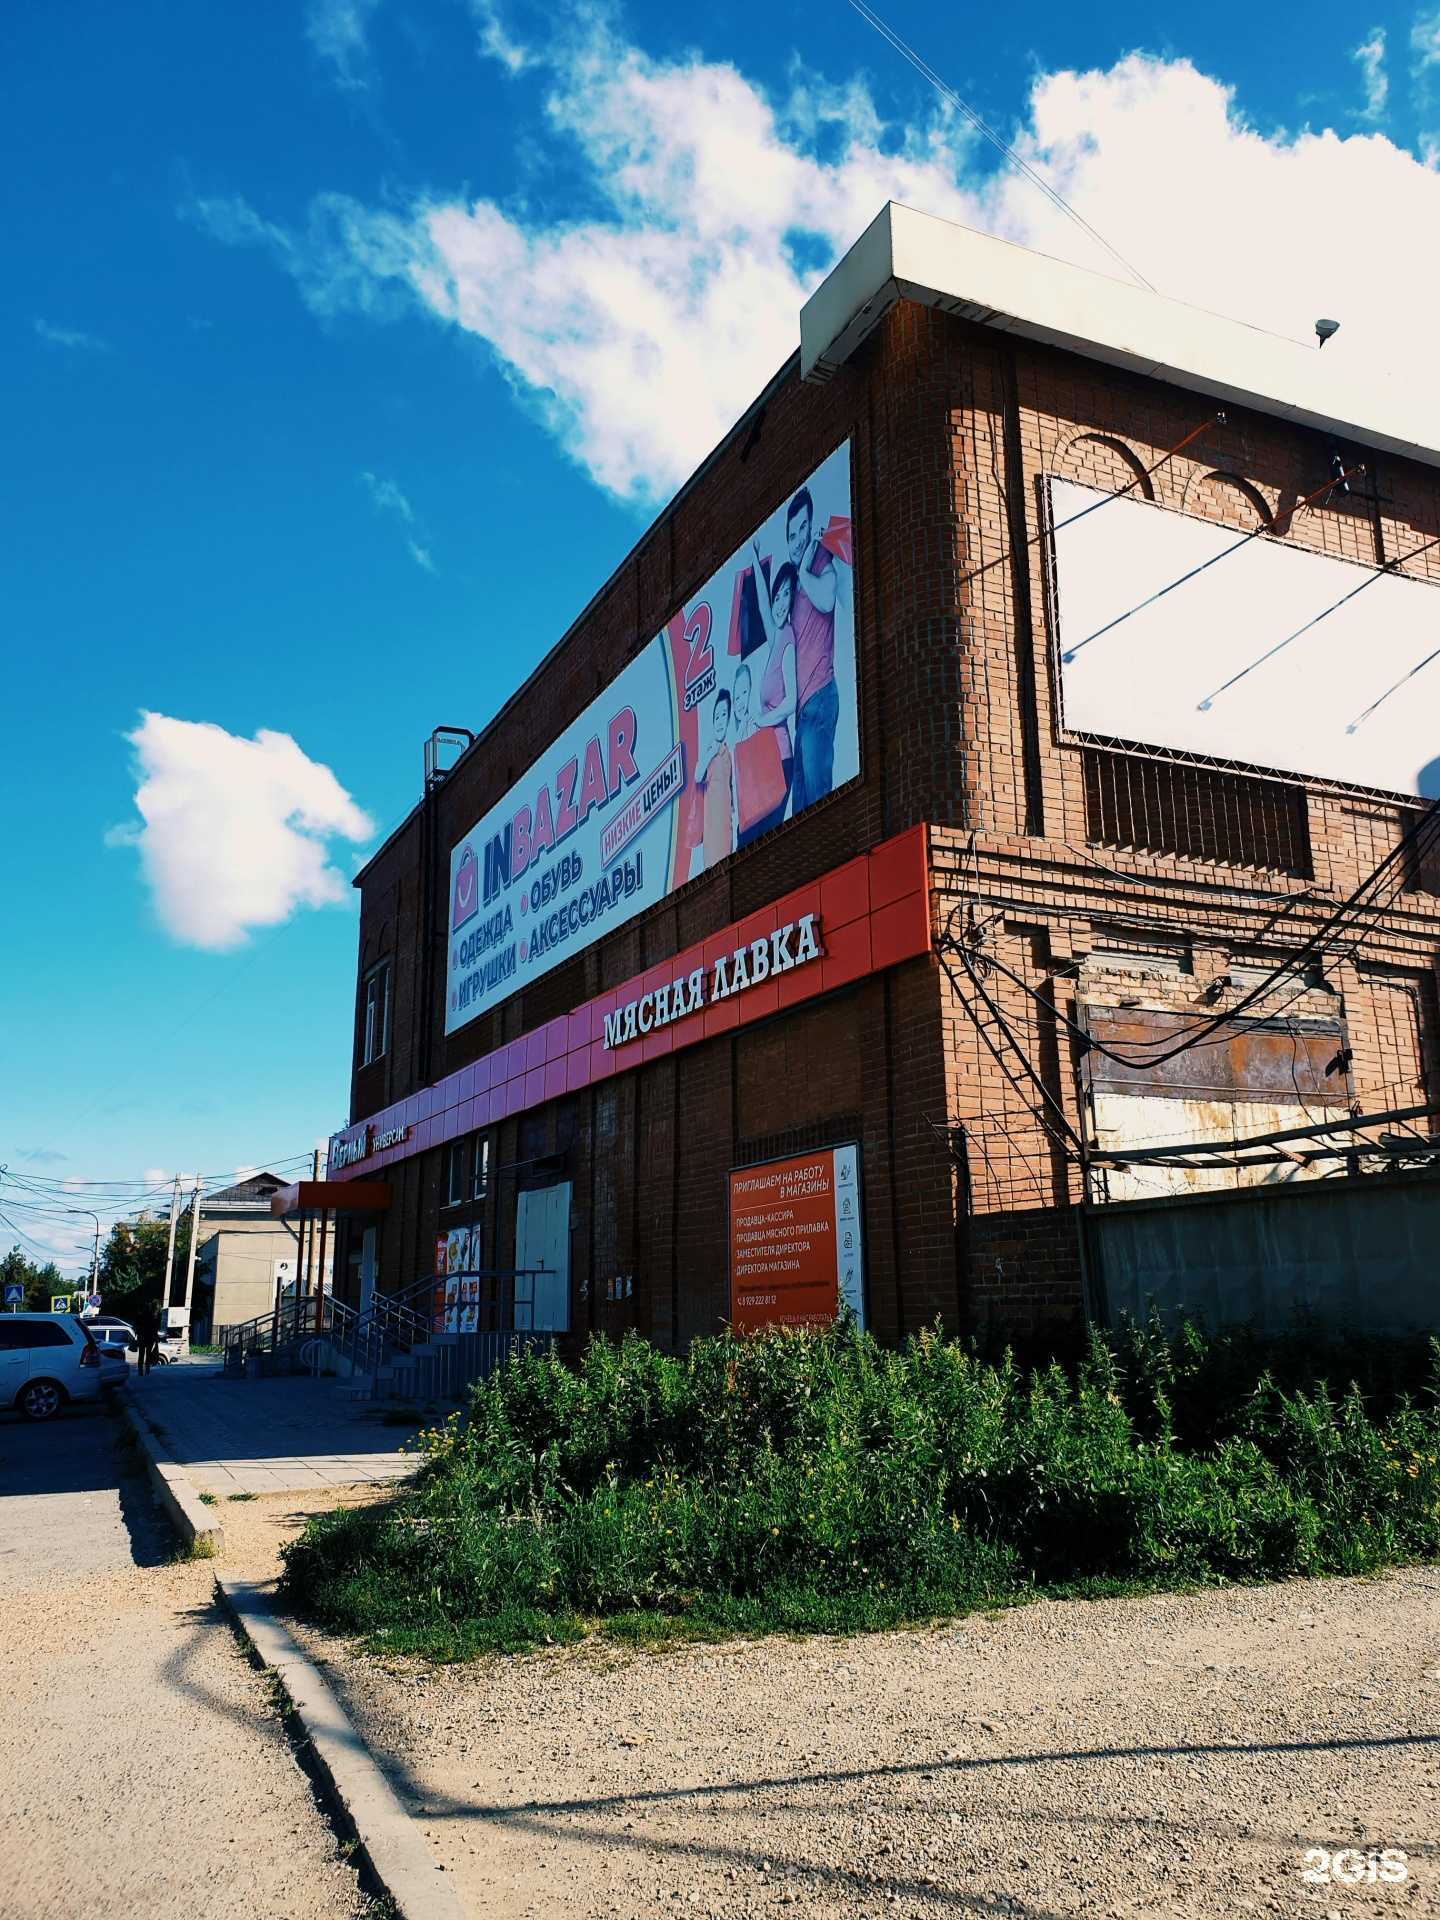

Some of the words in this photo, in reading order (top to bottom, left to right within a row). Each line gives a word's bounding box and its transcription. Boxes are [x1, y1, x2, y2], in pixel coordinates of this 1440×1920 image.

[683, 602, 713, 690] 2
[482, 706, 640, 906] INBAZAR
[604, 804, 641, 852] НИЗКИЕ
[643, 760, 678, 812] ЦЕНЫ!
[457, 944, 517, 1009] ИГРУШКИ
[528, 850, 644, 961] АКСЕССУАРЫ
[459, 905, 513, 968] ОДЕЖДА
[531, 851, 583, 913] ОБУВЬ
[603, 967, 704, 1050] МЯСНАЯ
[711, 913, 822, 1001] ЛАВКА
[733, 1174, 781, 1195] ПРИГЛАШАЕМ
[782, 1173, 793, 1183] НА
[794, 1165, 824, 1181] РАБОТУ
[780, 1188, 785, 1198] В
[786, 1178, 830, 1197] МАГАЗИНЫ
